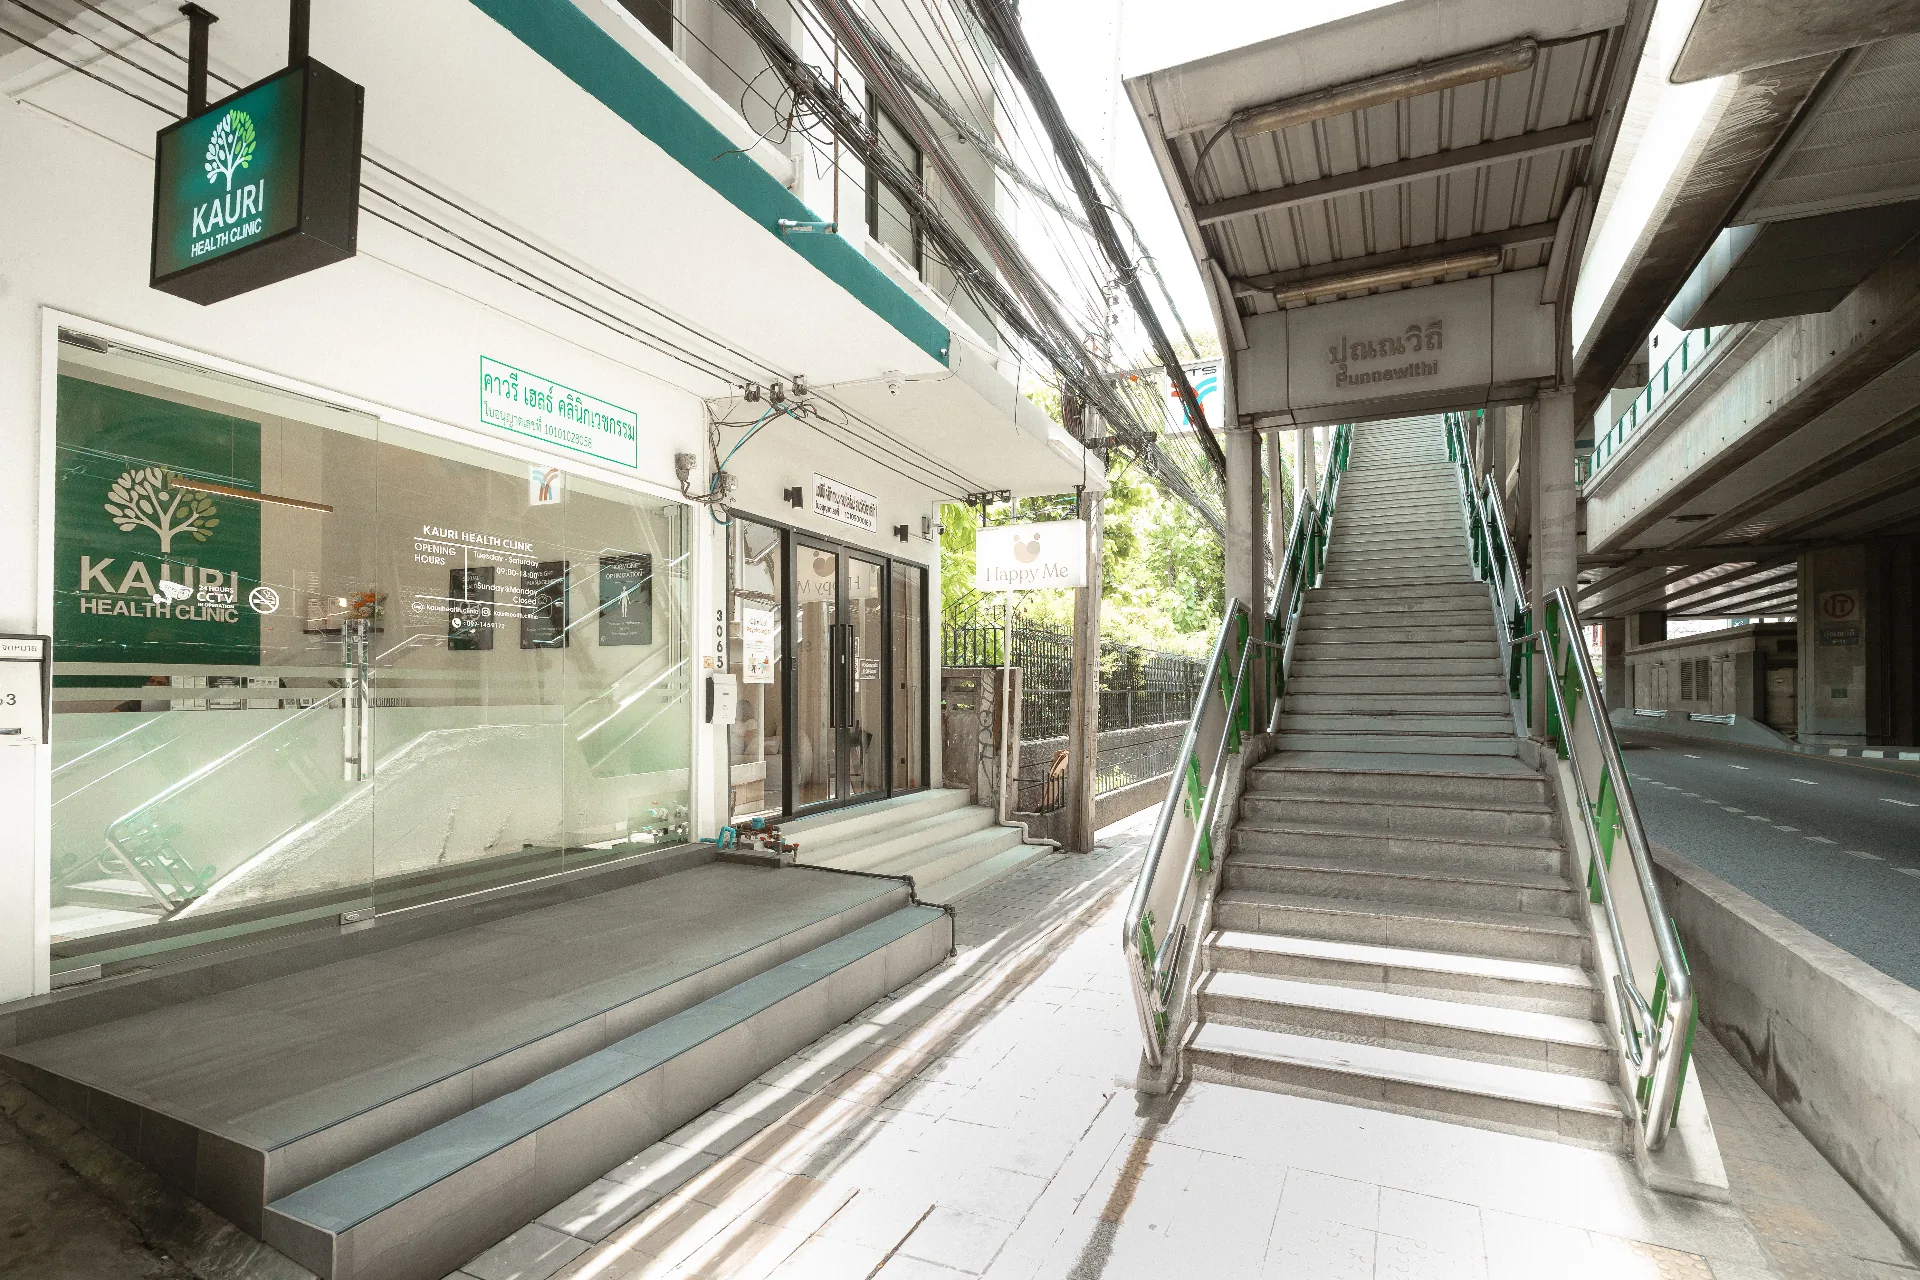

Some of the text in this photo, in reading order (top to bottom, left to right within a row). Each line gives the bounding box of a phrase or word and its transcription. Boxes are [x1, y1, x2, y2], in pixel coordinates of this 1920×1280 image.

[192, 179, 264, 238] KAURI
[191, 218, 262, 257] HEALTH CLINIC
[1329, 320, 1443, 373] ปุณณวิถี
[1335, 359, 1438, 387] Punnawithi
[483, 372, 519, 402] คาวรี
[558, 393, 635, 442] คลินิกเวชกรรม
[414, 542, 457, 556] OPENING
[423, 525, 534, 552] KAURI HEALTH CLINIC
[414, 554, 446, 566] HOURS
[473, 551, 504, 563] Tuesday
[509, 556, 539, 568] Saturday
[80, 555, 238, 603] KAURI
[986, 563, 1069, 584] Happy Me
[196, 592, 234, 604] CCTV
[198, 585, 234, 594] 24 HOURS
[512, 595, 537, 605] Closed
[80, 598, 239, 624] HEALTH CLINIC
[716, 609, 724, 669] 3065
